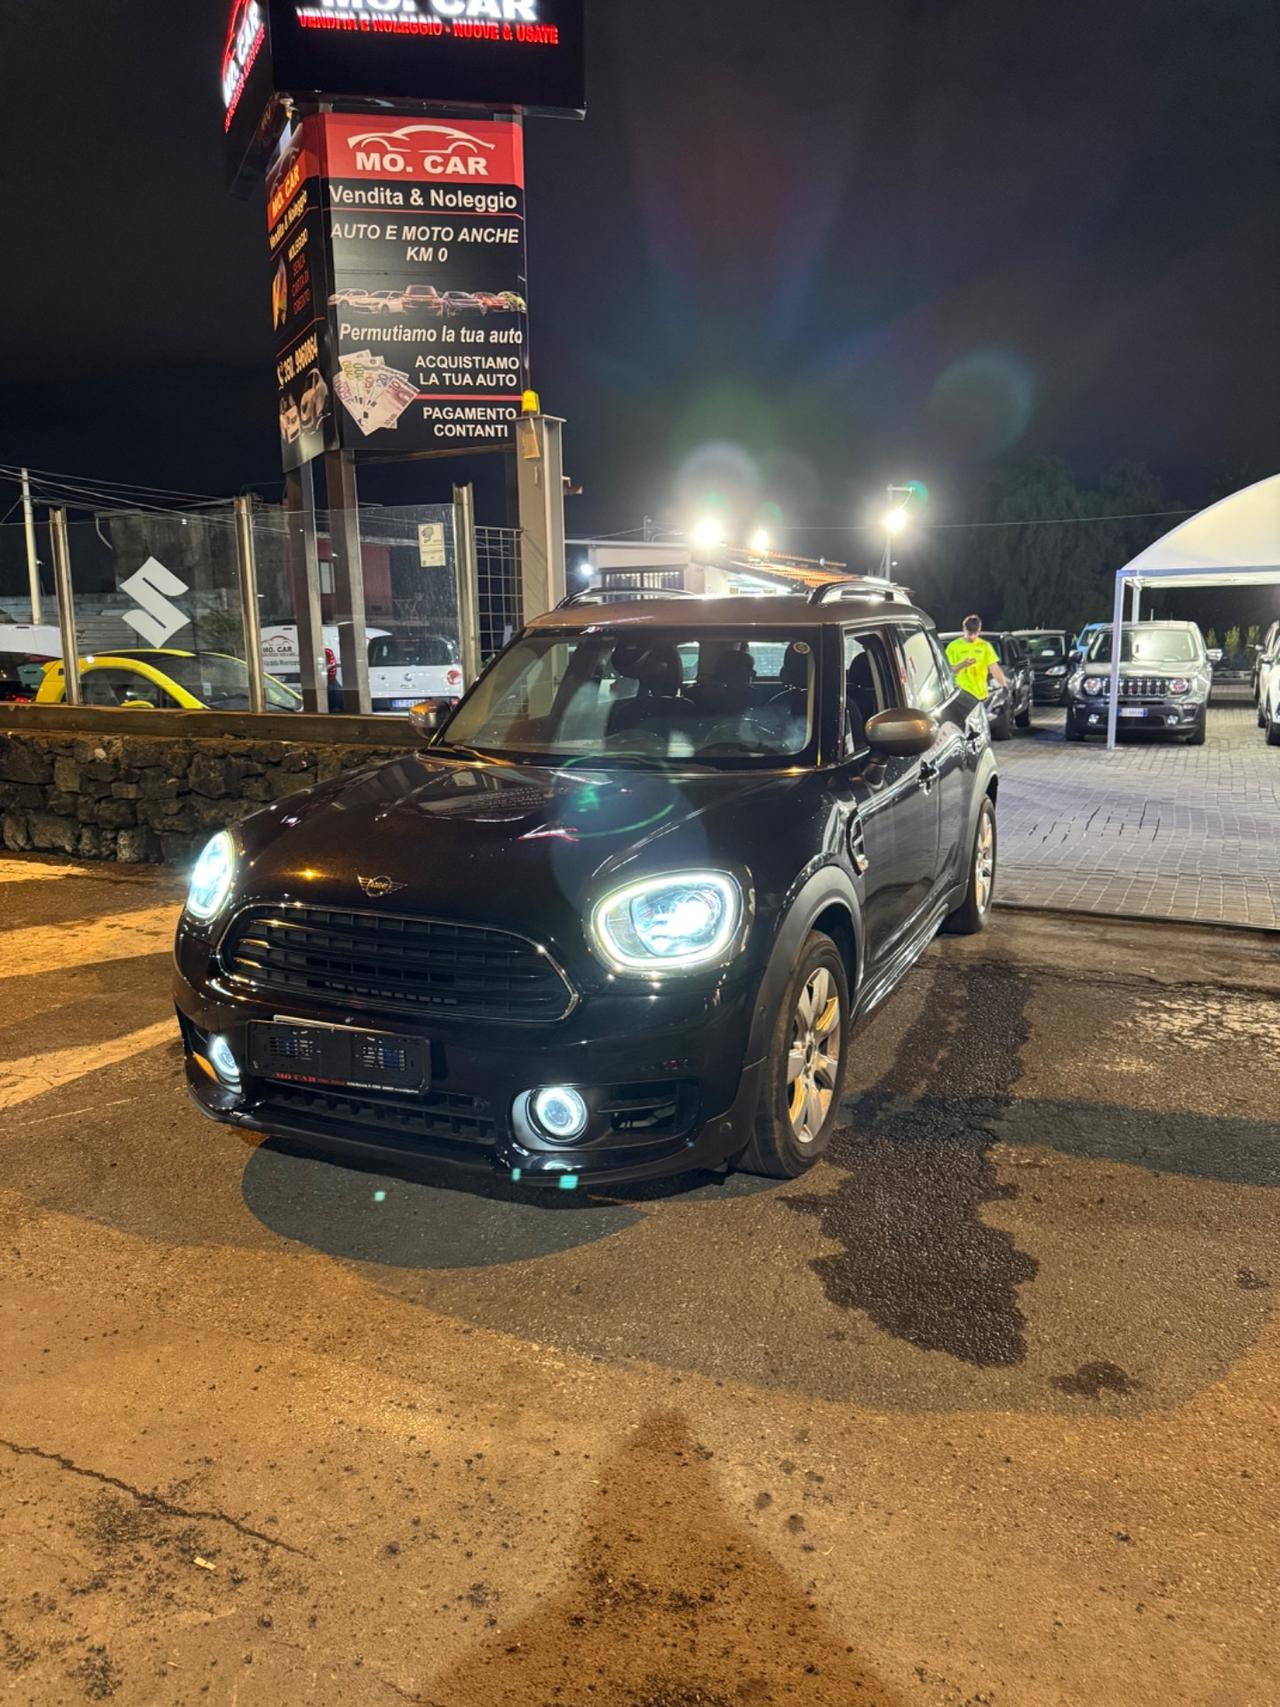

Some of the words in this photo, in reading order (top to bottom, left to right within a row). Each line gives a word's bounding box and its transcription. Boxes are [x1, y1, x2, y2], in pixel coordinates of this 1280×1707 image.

[297, 7, 358, 31] VENDITA
[359, 11, 370, 31] E
[371, 13, 443, 36] NOLEGGIO
[452, 17, 500, 40] NUOVE
[502, 21, 513, 41] &
[515, 22, 559, 44] USATE
[355, 151, 413, 173] MO.
[423, 154, 489, 176] CAR
[328, 184, 404, 207] Vendita
[409, 188, 424, 206] &
[429, 189, 518, 213] Noleggio
[330, 223, 381, 240] AUTO
[385, 225, 398, 241] E
[401, 226, 454, 243] MOTO
[457, 227, 520, 245] ANCHE
[406, 246, 434, 262] KM
[438, 247, 448, 263] 0
[339, 323, 437, 343] Permutiamo
[441, 325, 456, 343] la
[459, 326, 485, 344] tua
[489, 327, 523, 345] auto
[415, 355, 521, 371] ACQUISTIAMO
[419, 373, 440, 387] LA
[443, 374, 473, 388] TUA
[476, 375, 518, 388] AUTO
[423, 407, 518, 421] PAGAMENTO
[434, 424, 510, 438] CONTANTI
